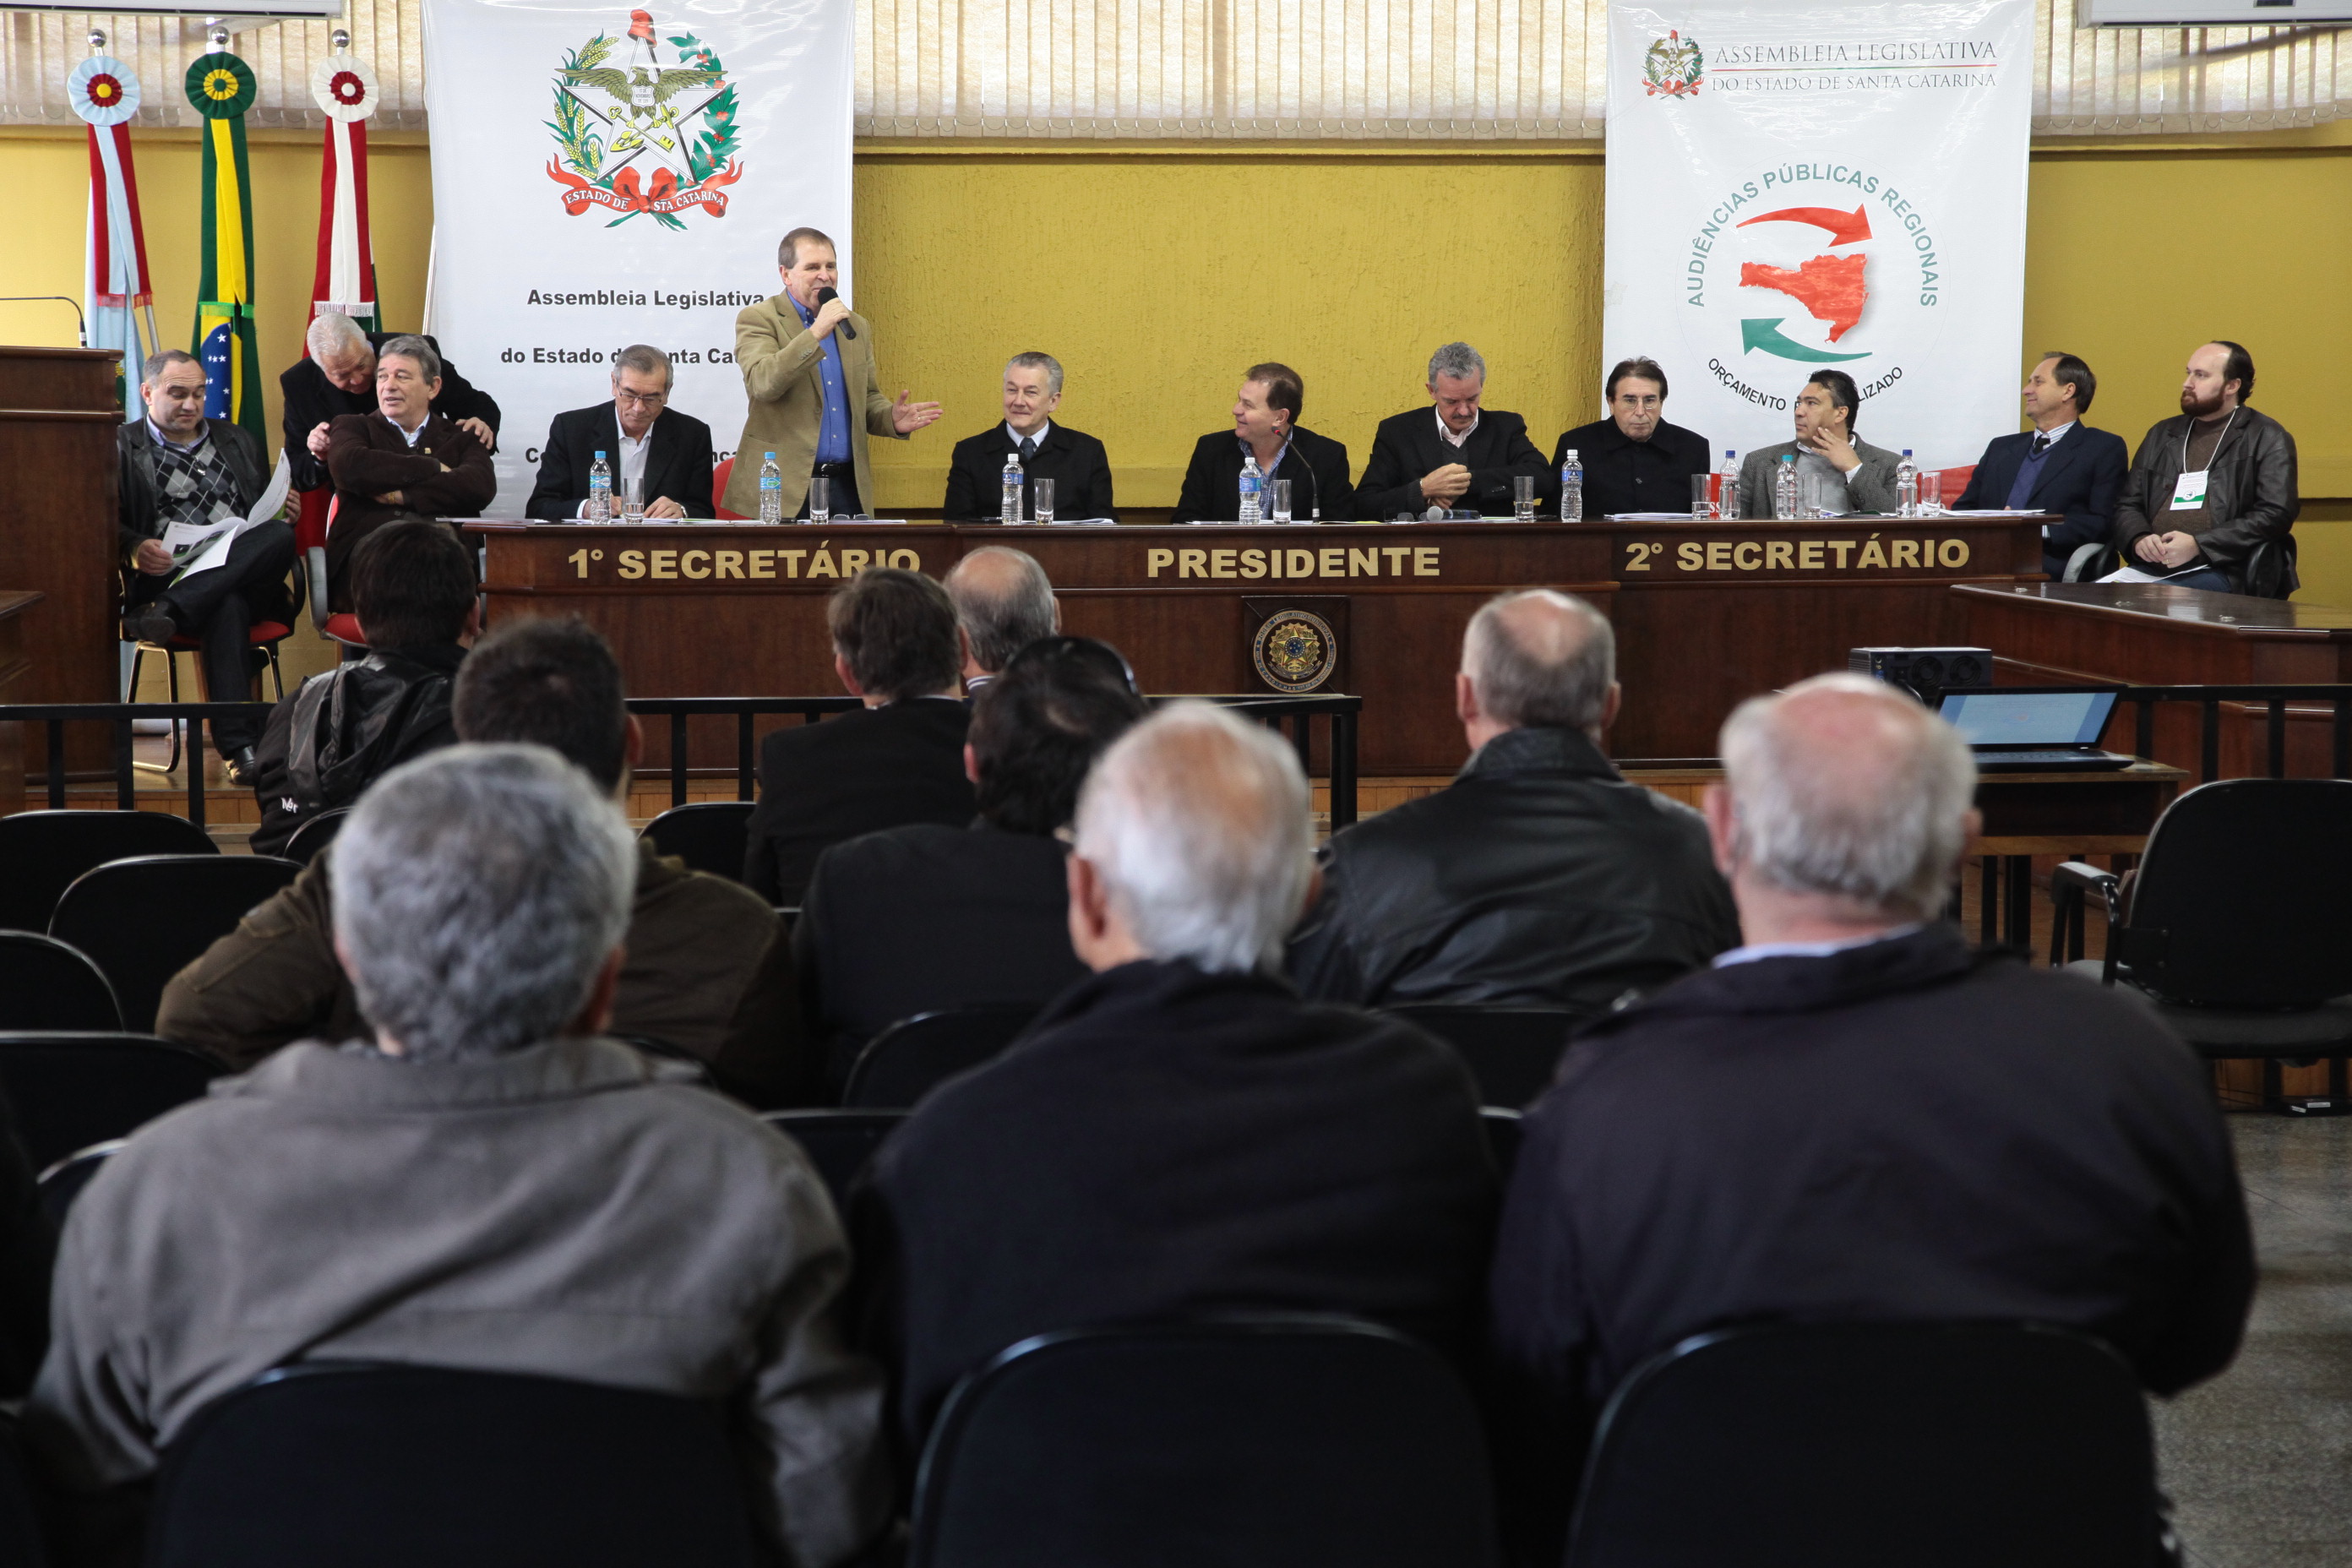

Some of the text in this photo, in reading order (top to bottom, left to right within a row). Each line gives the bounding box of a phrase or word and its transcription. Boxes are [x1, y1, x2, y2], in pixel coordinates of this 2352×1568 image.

[1715, 41, 1997, 64] ASSEMBLEIA LEGISLATIVA
[1712, 77, 1740, 91] DO
[1745, 76, 1812, 91] ESTADO
[1818, 76, 1840, 90] DE
[1846, 74, 1902, 90] SANTA
[1908, 73, 1997, 89] CATARINA
[565, 189, 611, 204] ESTADO
[612, 199, 629, 210] DE
[676, 191, 725, 206] CATARINA
[1686, 162, 1939, 308] AUDIÊNCIAS PÚBLICAS REGIONAIS
[527, 290, 765, 310] Assembleia Legislativa
[500, 347, 525, 363] do
[532, 347, 603, 363] Estado
[669, 348, 700, 364] nta
[1708, 357, 1787, 411] ORÇAMENTO
[618, 539, 921, 580] SECRETÁRIO
[1147, 546, 1440, 580] PRESIDENTE
[1676, 532, 1971, 571] SECRETÁRIO
